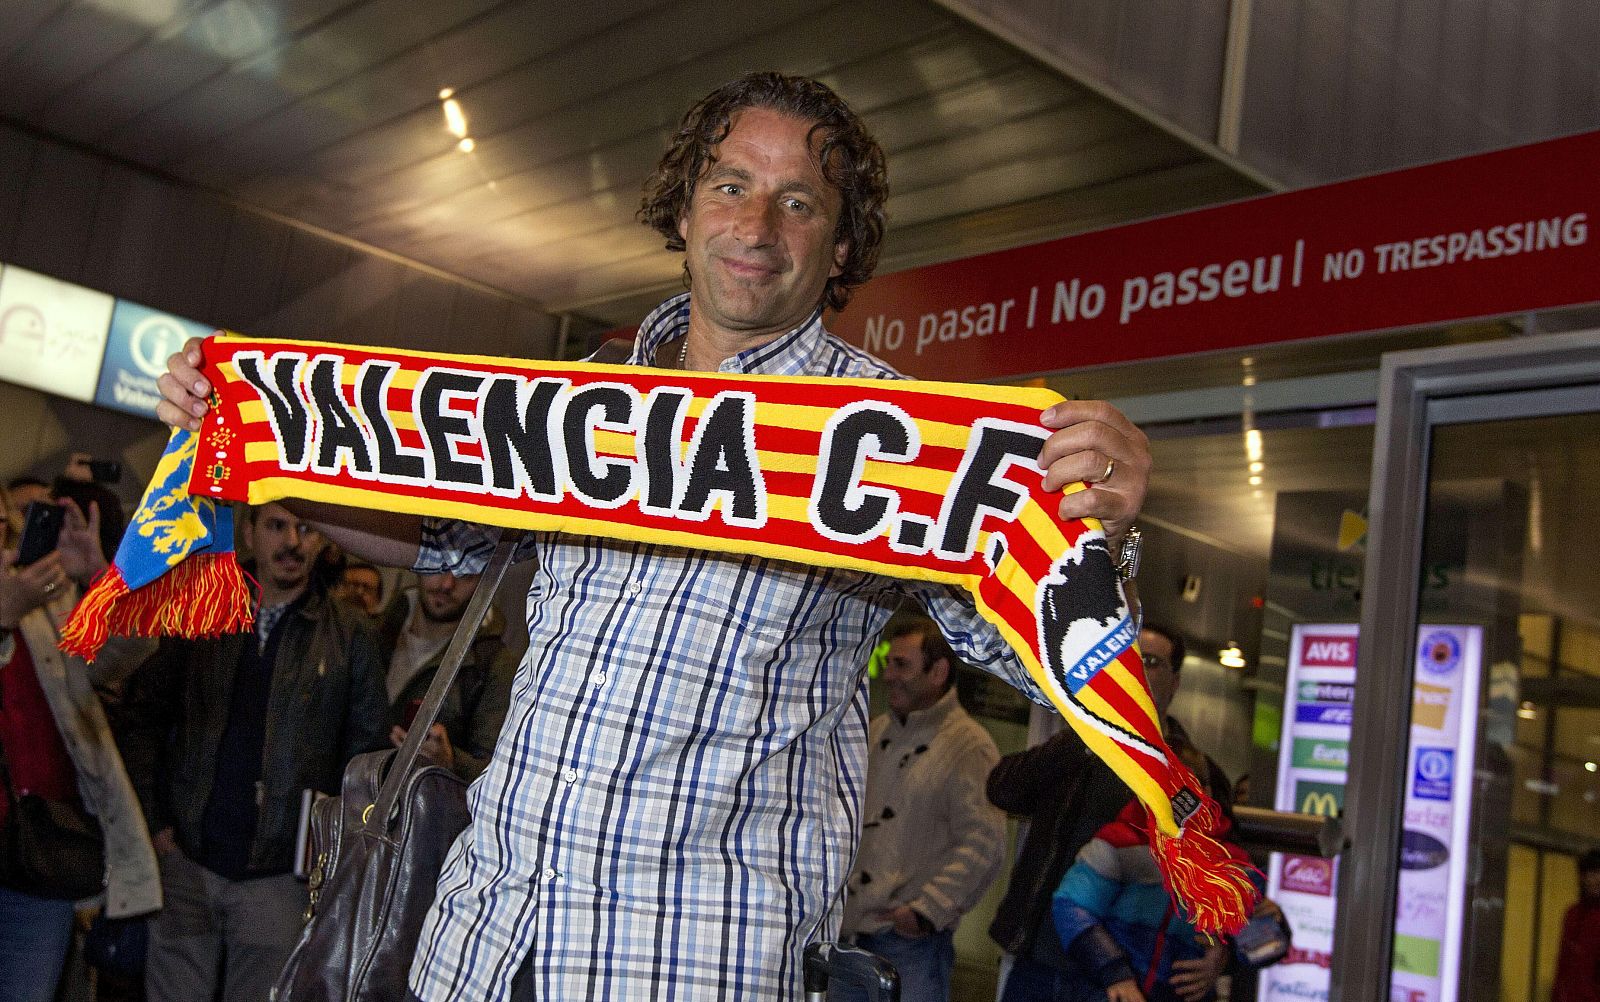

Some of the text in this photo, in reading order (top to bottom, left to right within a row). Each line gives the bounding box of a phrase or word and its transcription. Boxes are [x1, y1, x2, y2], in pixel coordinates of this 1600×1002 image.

[864, 212, 1588, 355] No pasar No passeu NO TRESPASSING
[233, 351, 765, 527] VALENCIA
[1306, 642, 1350, 661] AVIS
